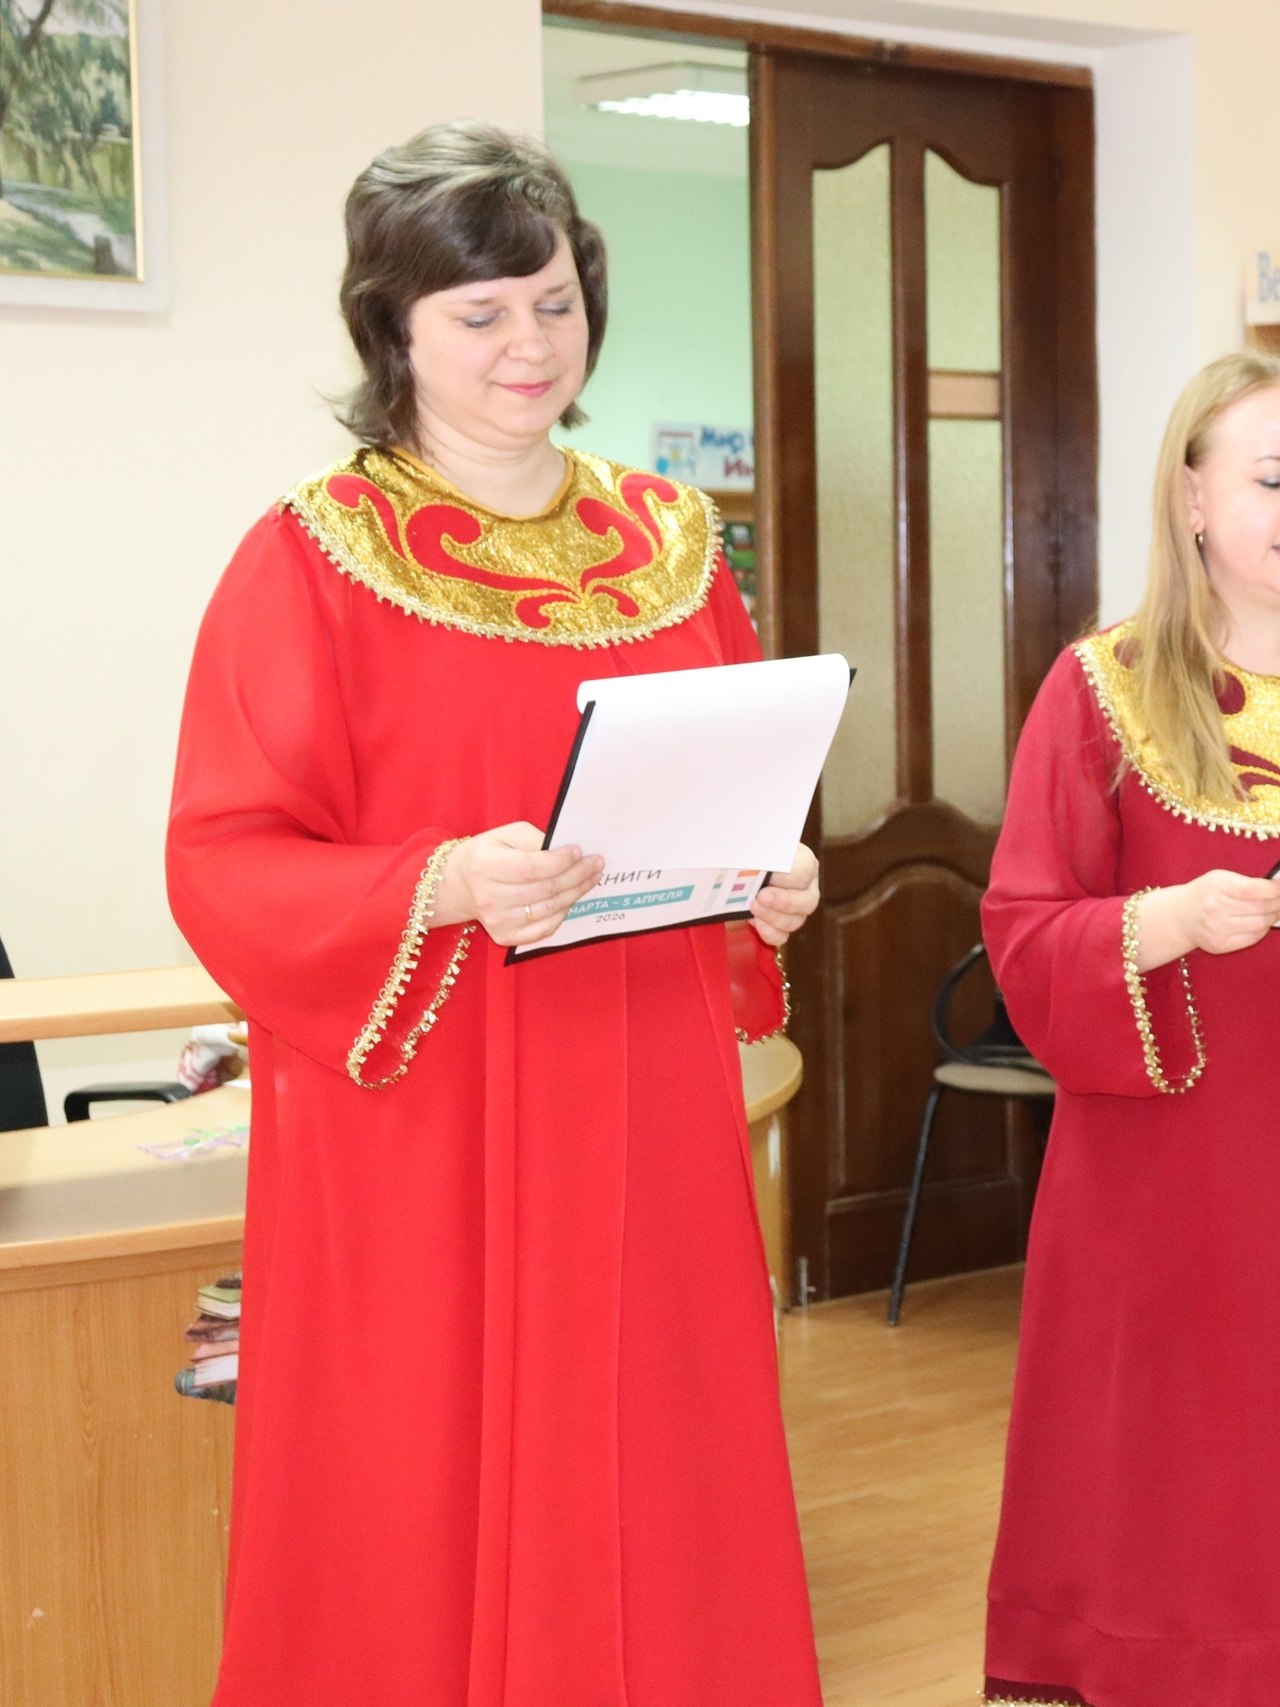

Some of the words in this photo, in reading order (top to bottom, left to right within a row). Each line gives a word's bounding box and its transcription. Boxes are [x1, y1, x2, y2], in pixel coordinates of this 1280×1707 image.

[597, 868, 662, 886] НИГИ
[622, 896, 632, 907] 5
[632, 889, 685, 906] АПРЕЛЯ
[595, 911, 627, 924] 2026
